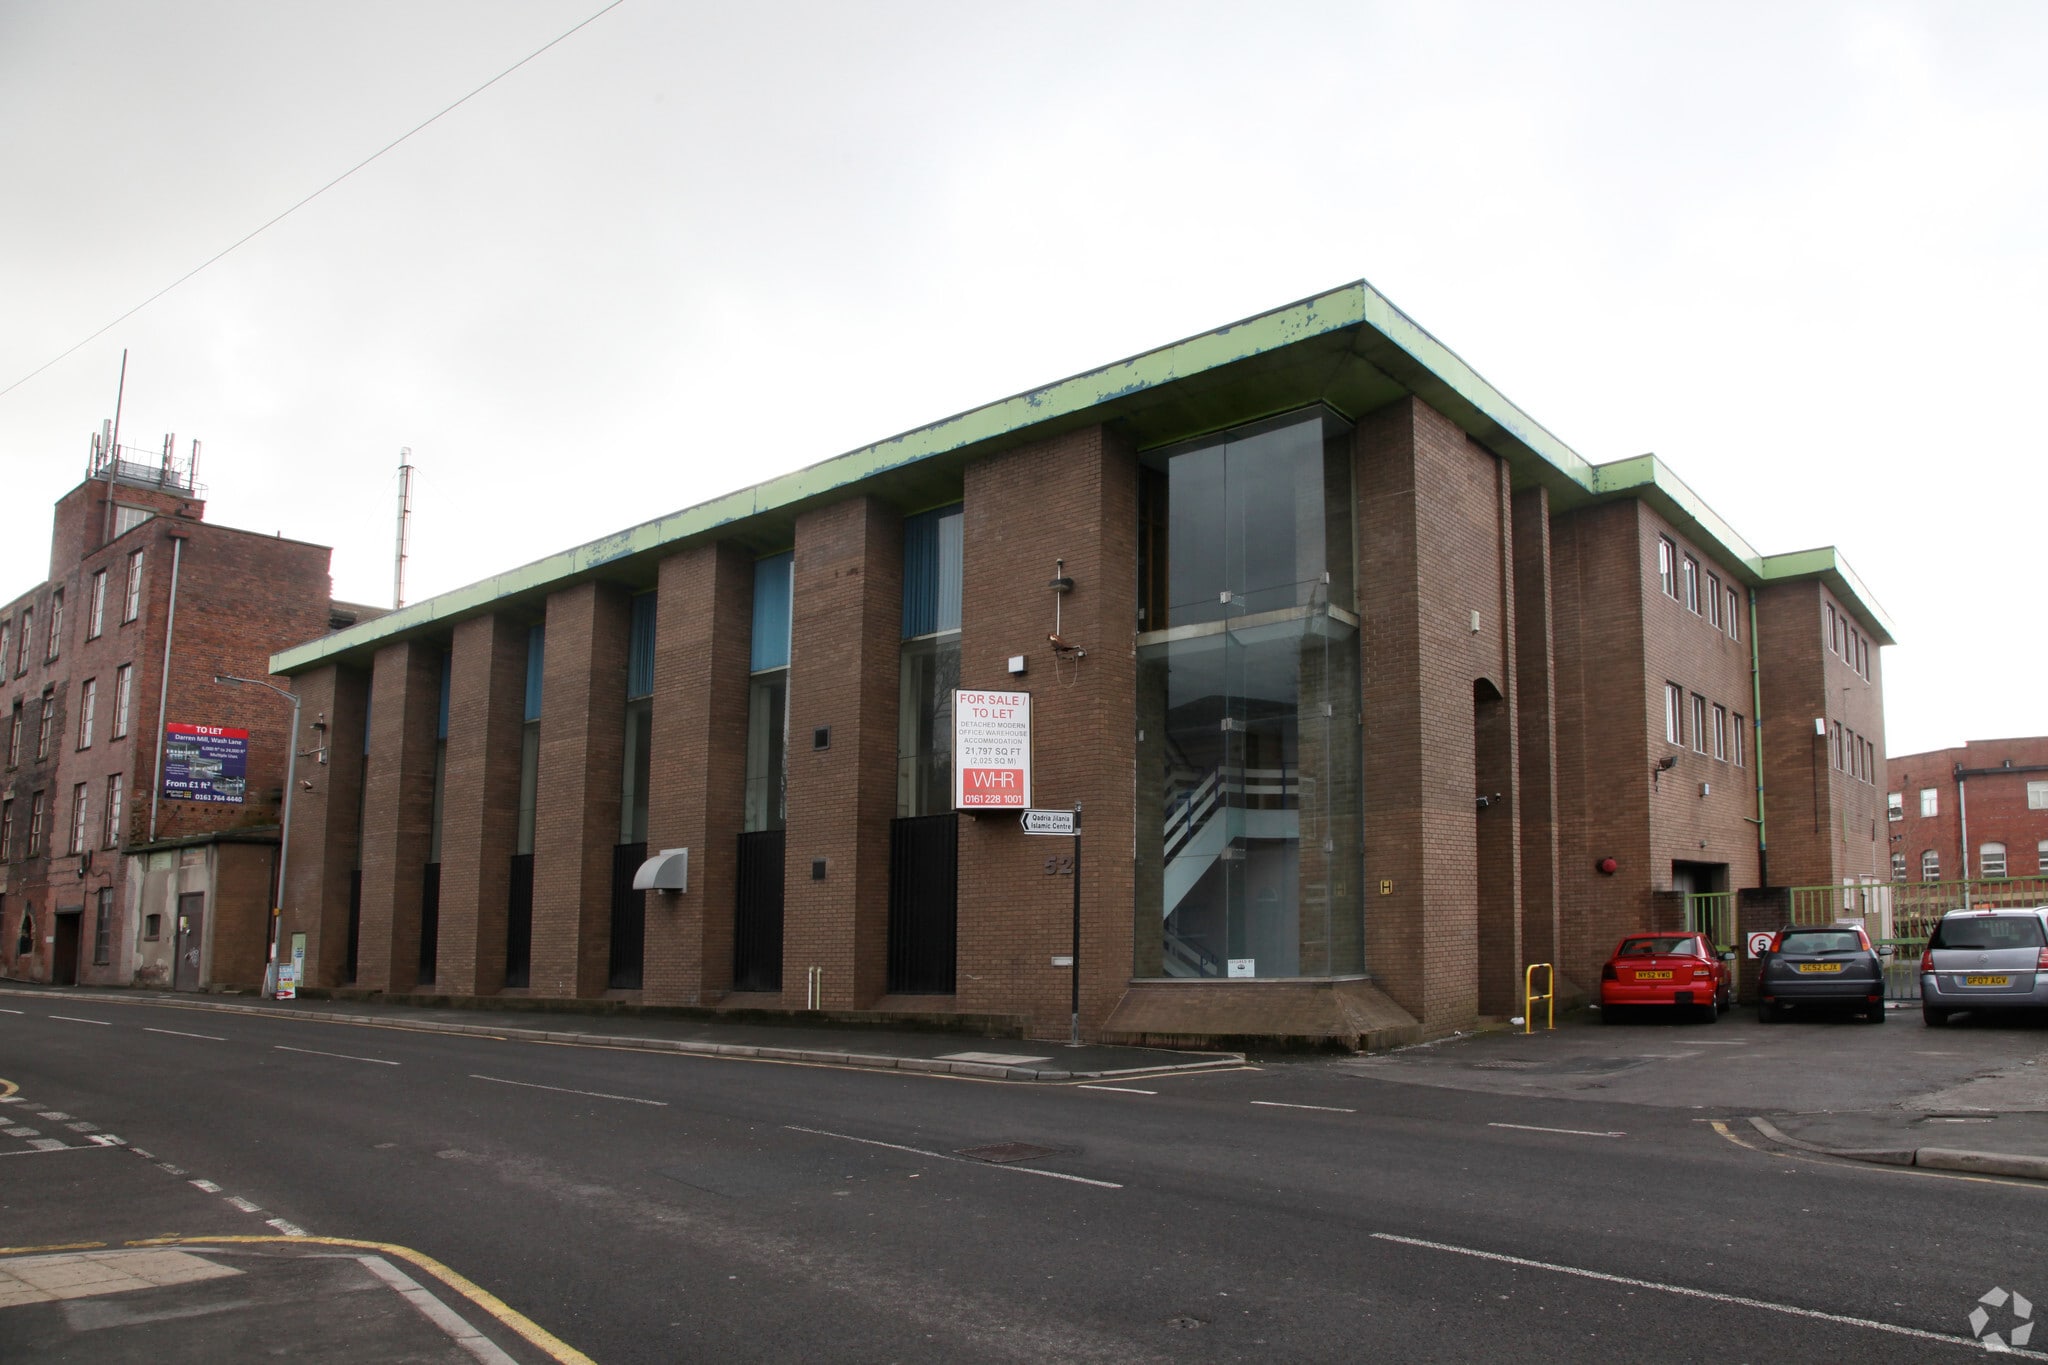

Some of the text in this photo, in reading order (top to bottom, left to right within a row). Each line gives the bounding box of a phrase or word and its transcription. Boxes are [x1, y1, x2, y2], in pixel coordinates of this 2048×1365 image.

[960, 694, 1026, 706] FOR SALE /
[972, 708, 1014, 719] TO LET
[196, 726, 223, 735] TO LET
[175, 734, 196, 742] Darren
[965, 747, 993, 756] 21,797
[995, 747, 1008, 756] SQ
[970, 757, 993, 766] (2,025
[1007, 758, 1017, 766] M)
[972, 771, 1015, 788] WHR
[166, 780, 211, 790] From £1 ft²
[965, 794, 1022, 804] 0161 228 1001
[1044, 856, 1073, 875] 52
[1382, 881, 1391, 893] H
[1758, 939, 1766, 951] 5
[1967, 976, 2006, 985] GF07 AGV
